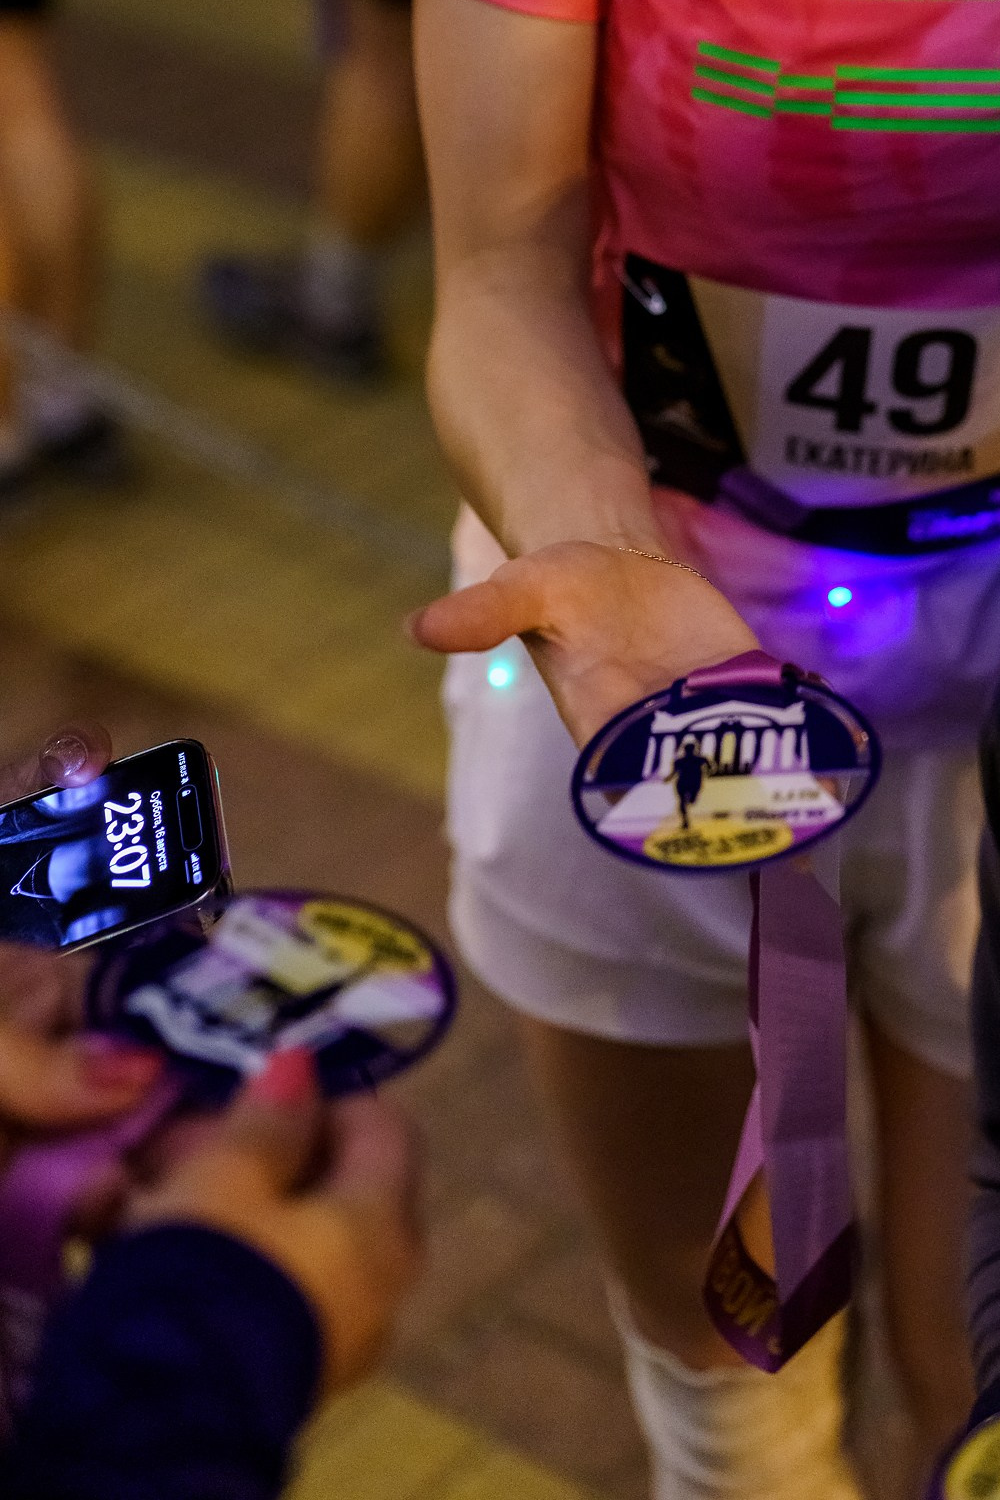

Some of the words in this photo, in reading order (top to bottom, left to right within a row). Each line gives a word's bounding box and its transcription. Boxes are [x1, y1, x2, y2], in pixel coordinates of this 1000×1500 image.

[784, 436, 976, 477] ЕКАТЕРИНА
[177, 752, 186, 765] MTS
[150, 790, 163, 829] Суббота,
[103, 792, 151, 888] 23:07
[155, 827, 166, 838] 16
[156, 838, 168, 872] августа
